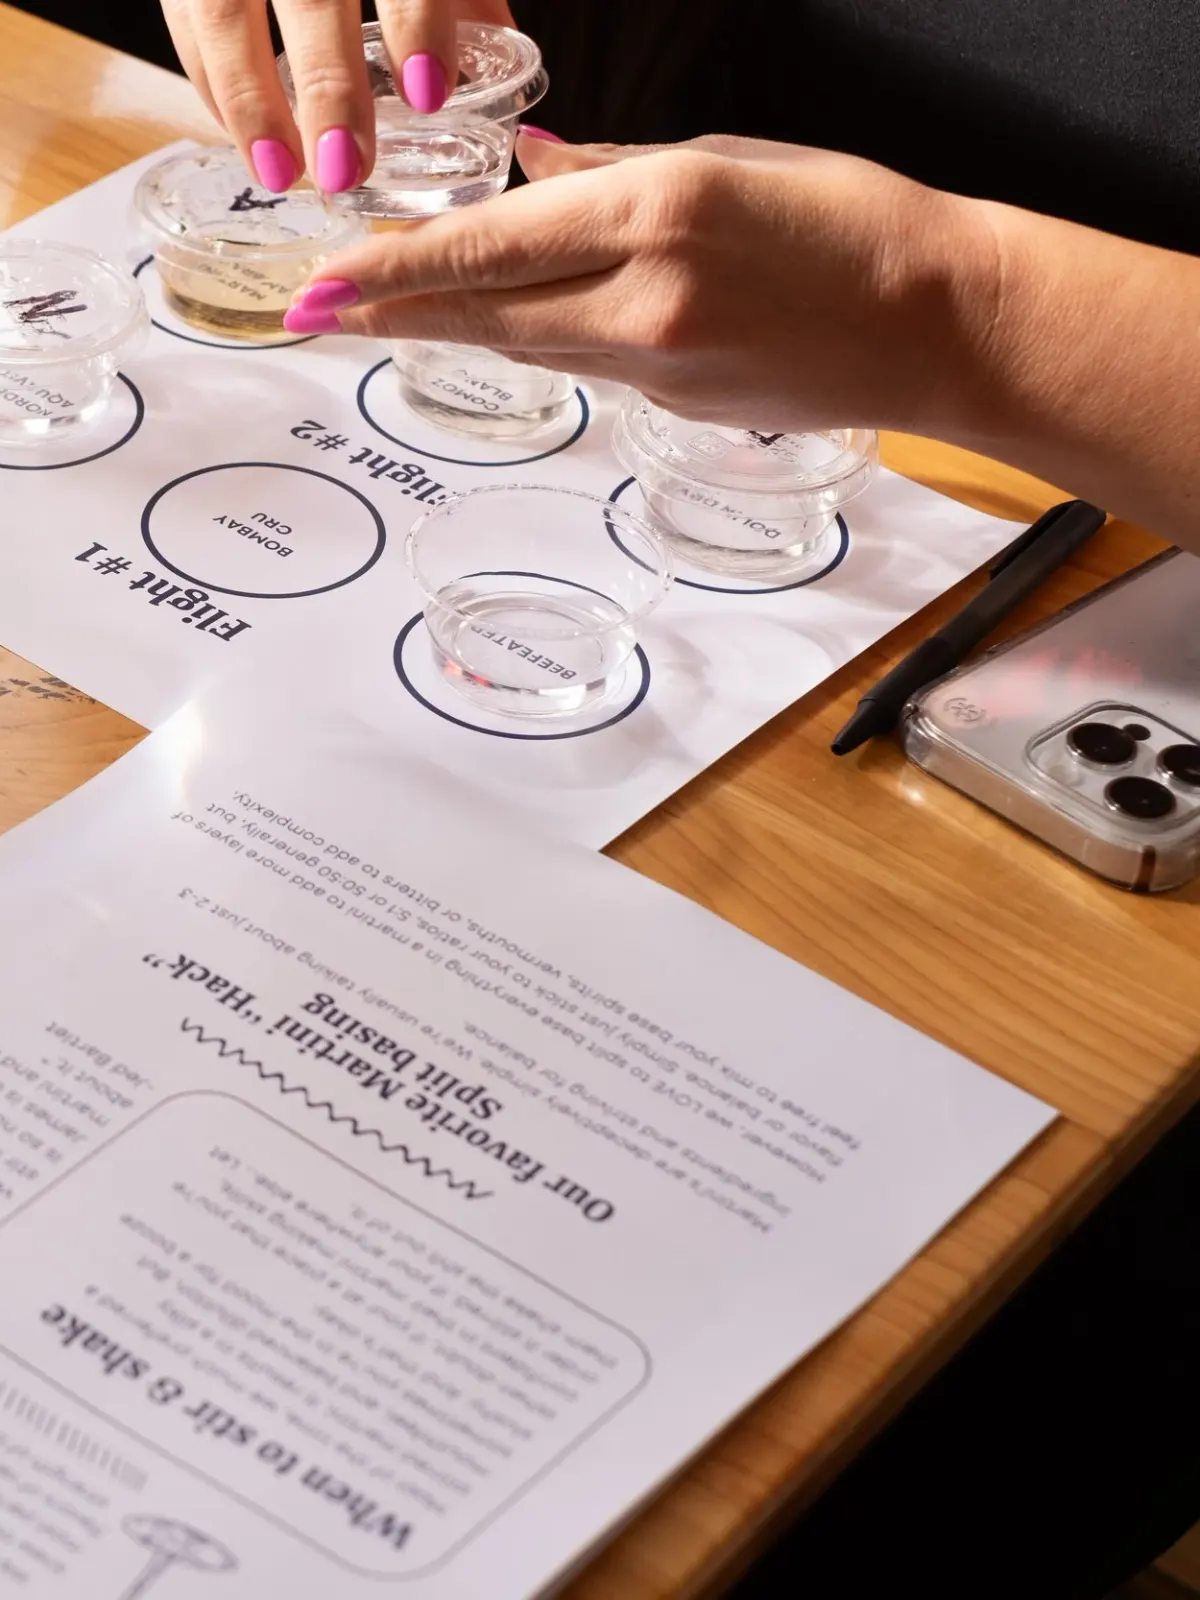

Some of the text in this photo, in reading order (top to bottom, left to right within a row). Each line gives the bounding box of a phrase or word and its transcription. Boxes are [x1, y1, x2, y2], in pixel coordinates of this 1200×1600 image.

[429, 377, 501, 413] COMOZ
[290, 419, 350, 452] #2
[212, 514, 295, 558] BOMBAY
[250, 512, 293, 535] CRU
[74, 541, 253, 643] Flight #1
[169, 811, 194, 823] of
[205, 802, 237, 824] but
[194, 820, 244, 853] layers
[241, 819, 320, 867] generally,
[244, 848, 291, 877] more
[288, 874, 326, 896] add
[316, 865, 367, 897] 50:50
[177, 887, 210, 908] 2-3
[325, 894, 346, 910] to
[366, 892, 388, 906] or
[385, 903, 412, 922] 5:1
[209, 903, 248, 927] just
[344, 906, 410, 944] martini
[243, 923, 296, 954] about
[410, 941, 424, 951] a
[416, 915, 468, 951] ratios,
[232, 790, 860, 1151] feel free to mix your base spirits, vermouths, or bitters to add complexity.
[296, 950, 355, 991] talking
[424, 948, 444, 965] in
[468, 949, 514, 976] your
[444, 958, 539, 1017] everything
[511, 971, 532, 989] to
[356, 987, 419, 1026] usually
[533, 985, 579, 1014] stick
[540, 1015, 586, 1046] base
[578, 1011, 620, 1038] just
[300, 992, 502, 1119] Split basing
[463, 1022, 537, 1070] balance.
[585, 1041, 628, 1069] split
[615, 1031, 679, 1074] Simply
[73, 1070, 134, 1109] about
[142, 953, 614, 1222] Our favorite Martini “Hack”
[537, 1067, 566, 1088] for
[628, 1065, 651, 1084] to
[3, 1088, 23, 1106] is
[36, 1080, 110, 1128] martini
[567, 1082, 639, 1128] striving
[650, 1079, 704, 1113] LOVE
[23, 1101, 87, 1143] James
[545, 1095, 651, 1160] deceptively
[704, 1109, 734, 1128] we
[762, 1117, 787, 1132] or
[17, 1130, 45, 1151] so
[637, 1124, 679, 1150] and
[43, 1147, 63, 1164] is
[653, 1159, 687, 1180] are
[40, 1305, 412, 1549] When to stir & shake
